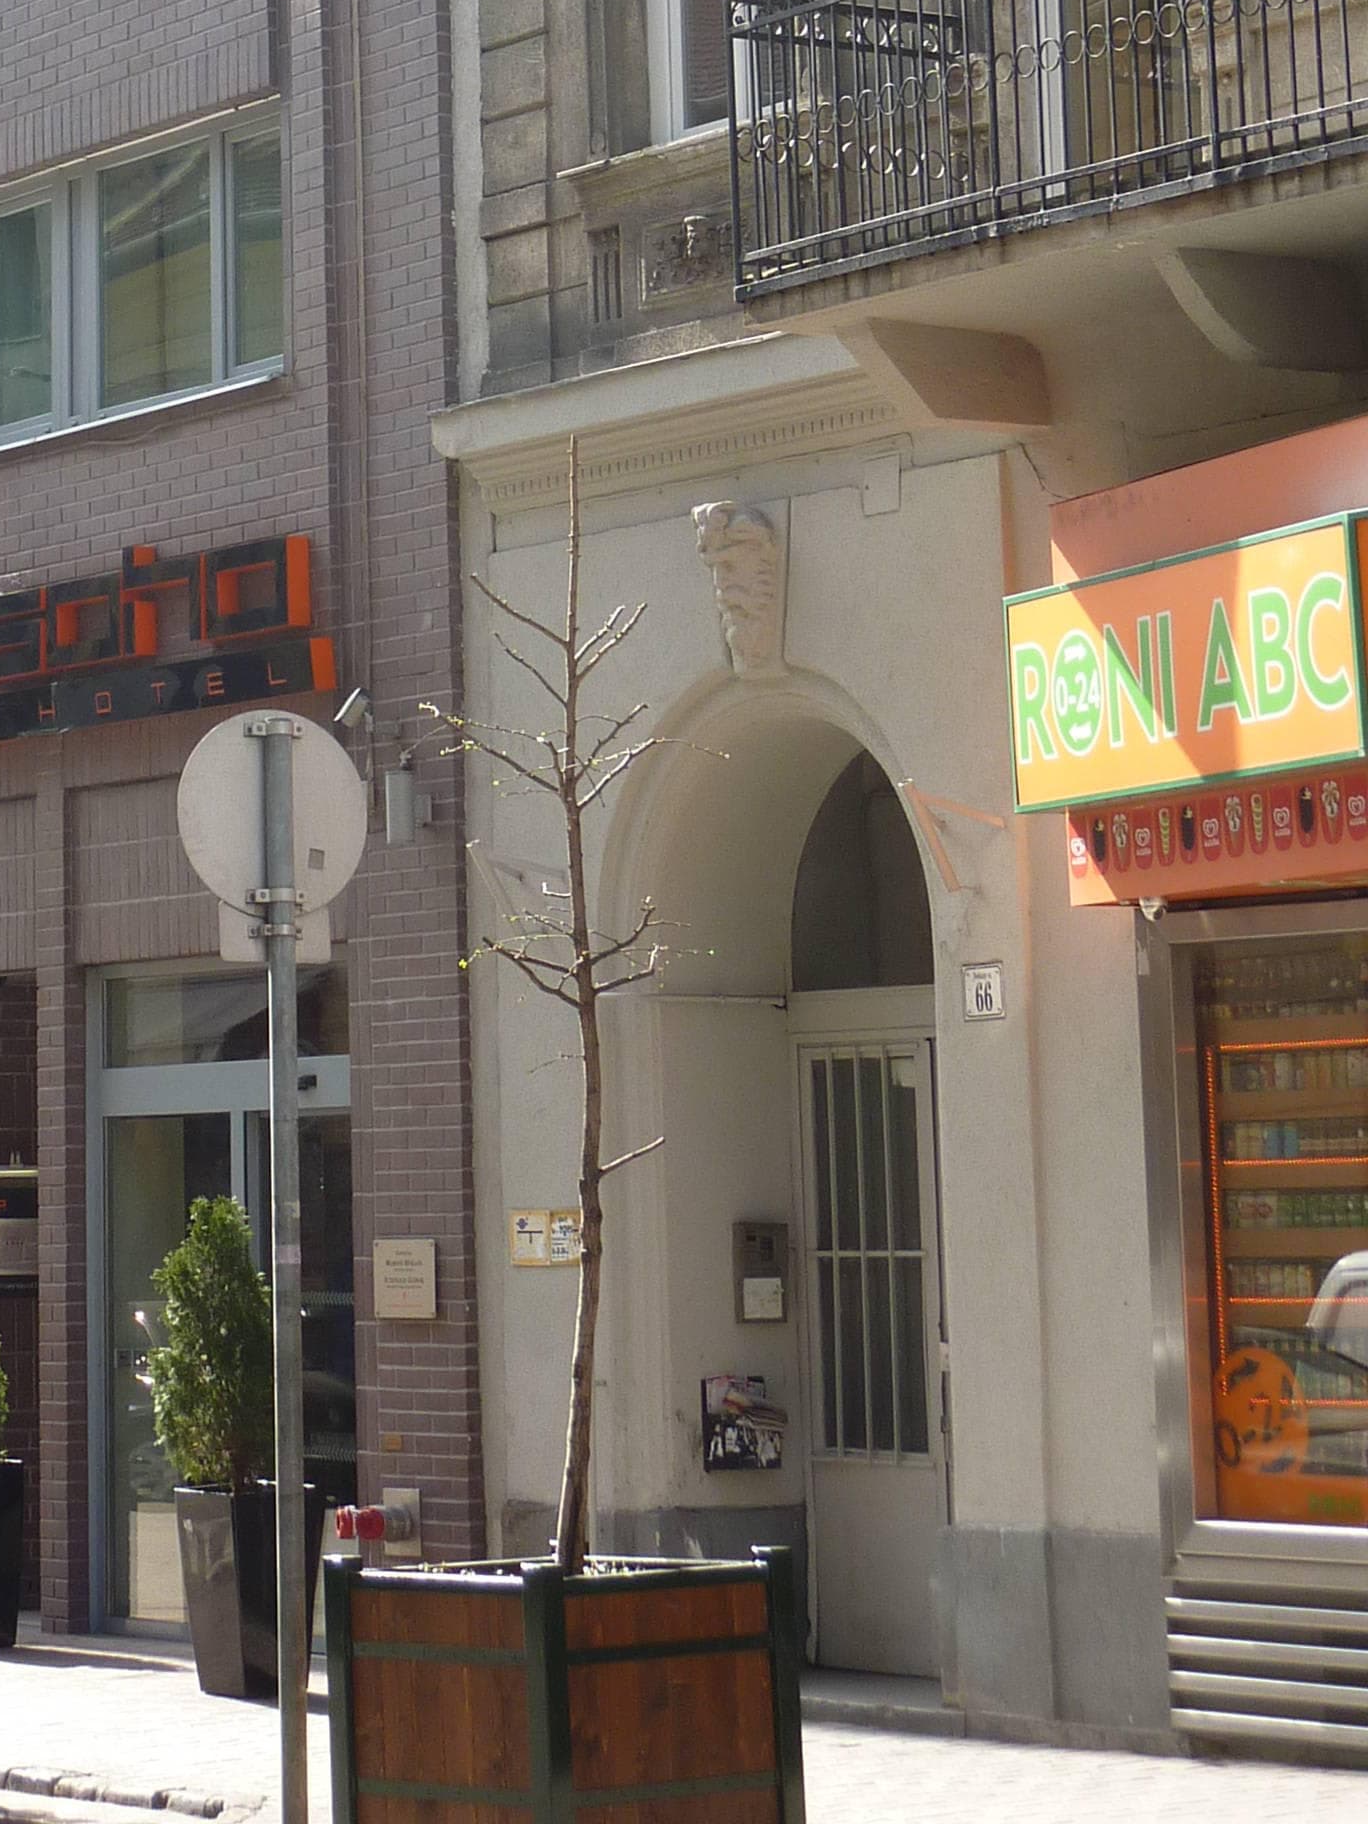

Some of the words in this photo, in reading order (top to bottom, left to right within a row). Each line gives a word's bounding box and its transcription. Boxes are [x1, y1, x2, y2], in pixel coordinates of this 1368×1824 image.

[37, 660, 288, 724] HOTEL
[1011, 610, 1179, 765] RONI
[1196, 570, 1354, 734] ABC
[1055, 667, 1101, 718] 0-24
[975, 980, 993, 1012] 66
